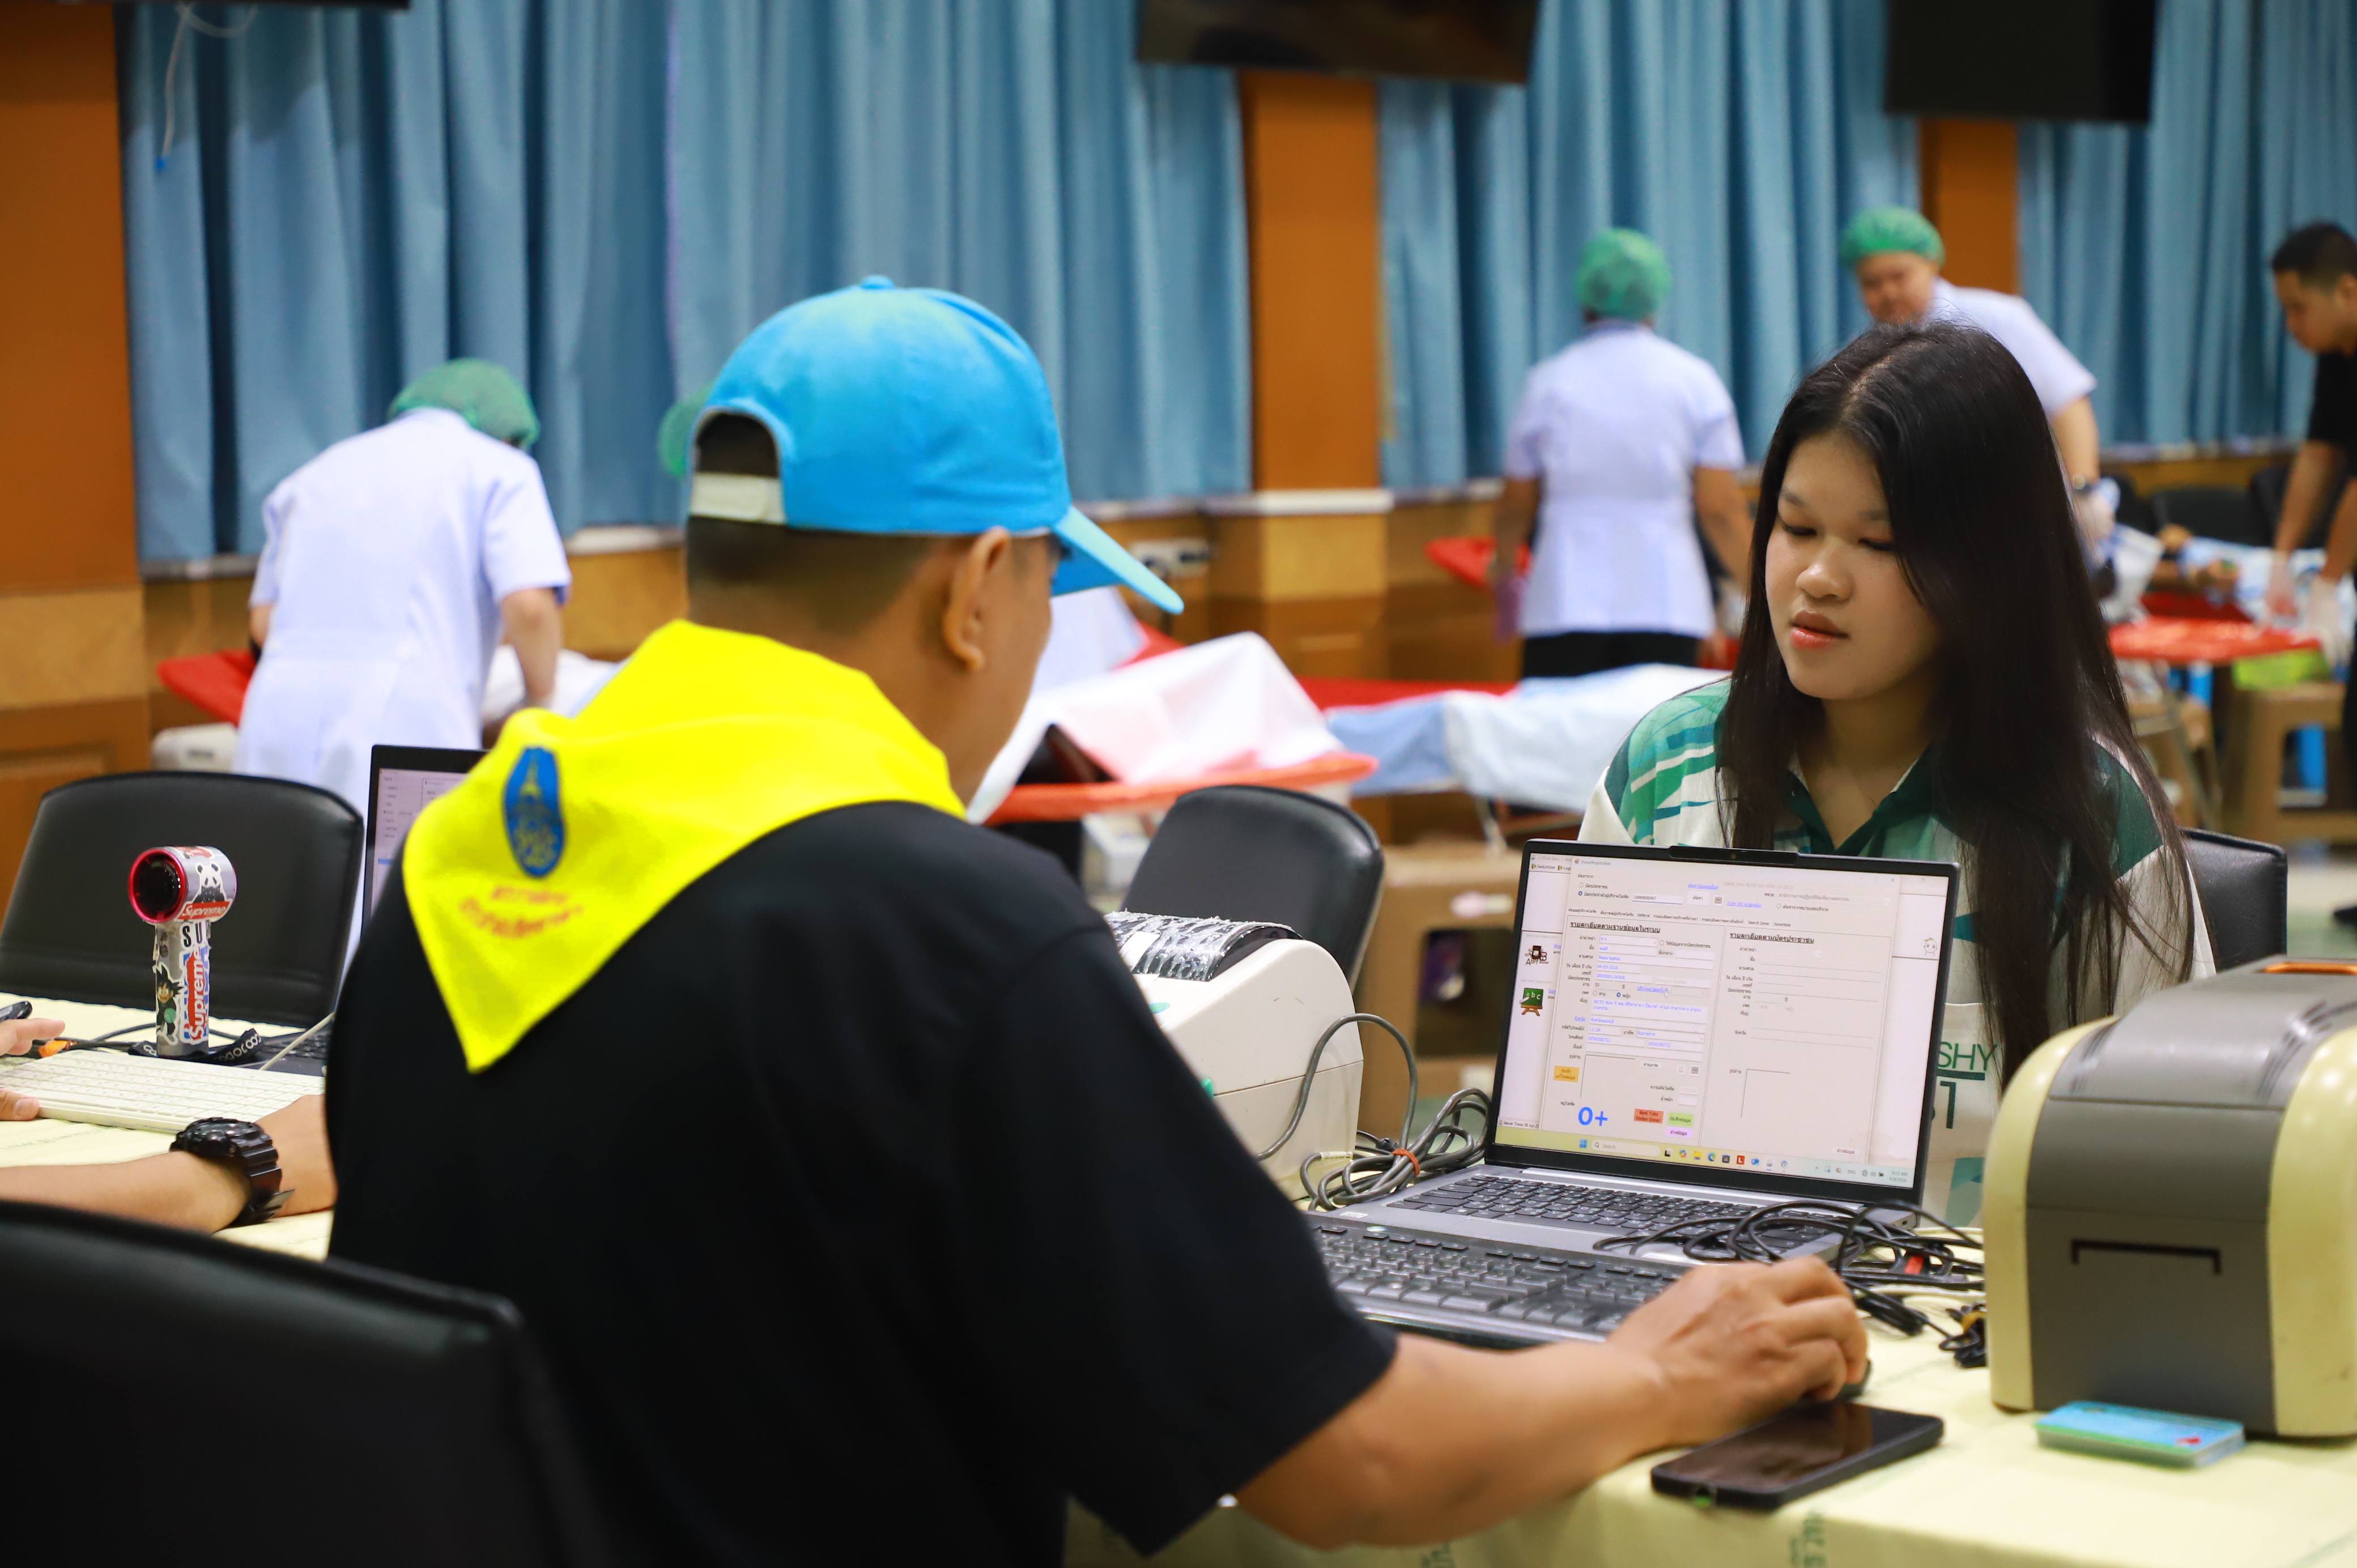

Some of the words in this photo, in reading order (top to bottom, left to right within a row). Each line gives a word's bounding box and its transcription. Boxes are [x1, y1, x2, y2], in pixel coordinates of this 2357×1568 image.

[182, 905, 226, 919] Supreme
[1570, 921, 1661, 934] รายละเอียดตามฐานข้อมูลในระบบ
[1729, 932, 1815, 944] รายละเอียดตามบัตรประชาชน
[190, 947, 206, 1040] Supreme
[1937, 1041, 1998, 1071] SHY
